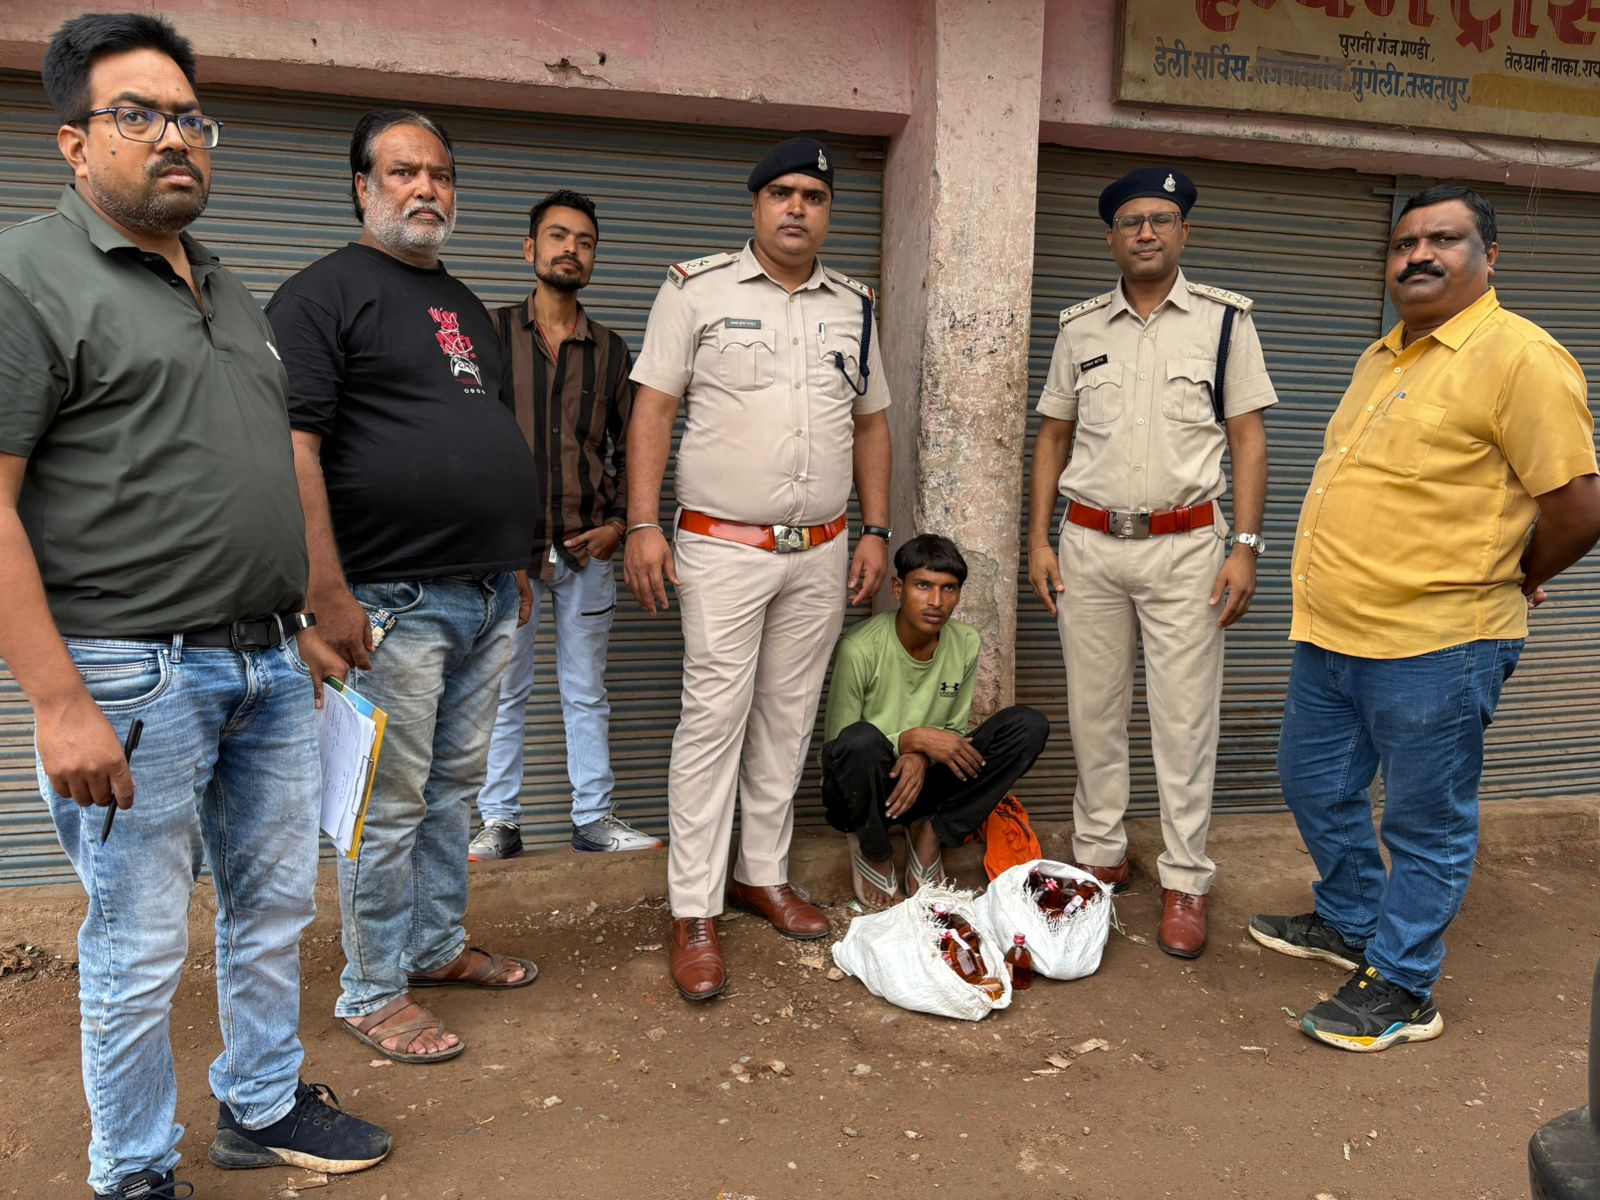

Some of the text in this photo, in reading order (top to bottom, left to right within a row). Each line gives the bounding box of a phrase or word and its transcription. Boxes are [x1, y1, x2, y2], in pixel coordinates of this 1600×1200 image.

[1154, 37, 1192, 78] डेली
[1338, 31, 1375, 57] पुरानी
[1377, 32, 1399, 56] गंज
